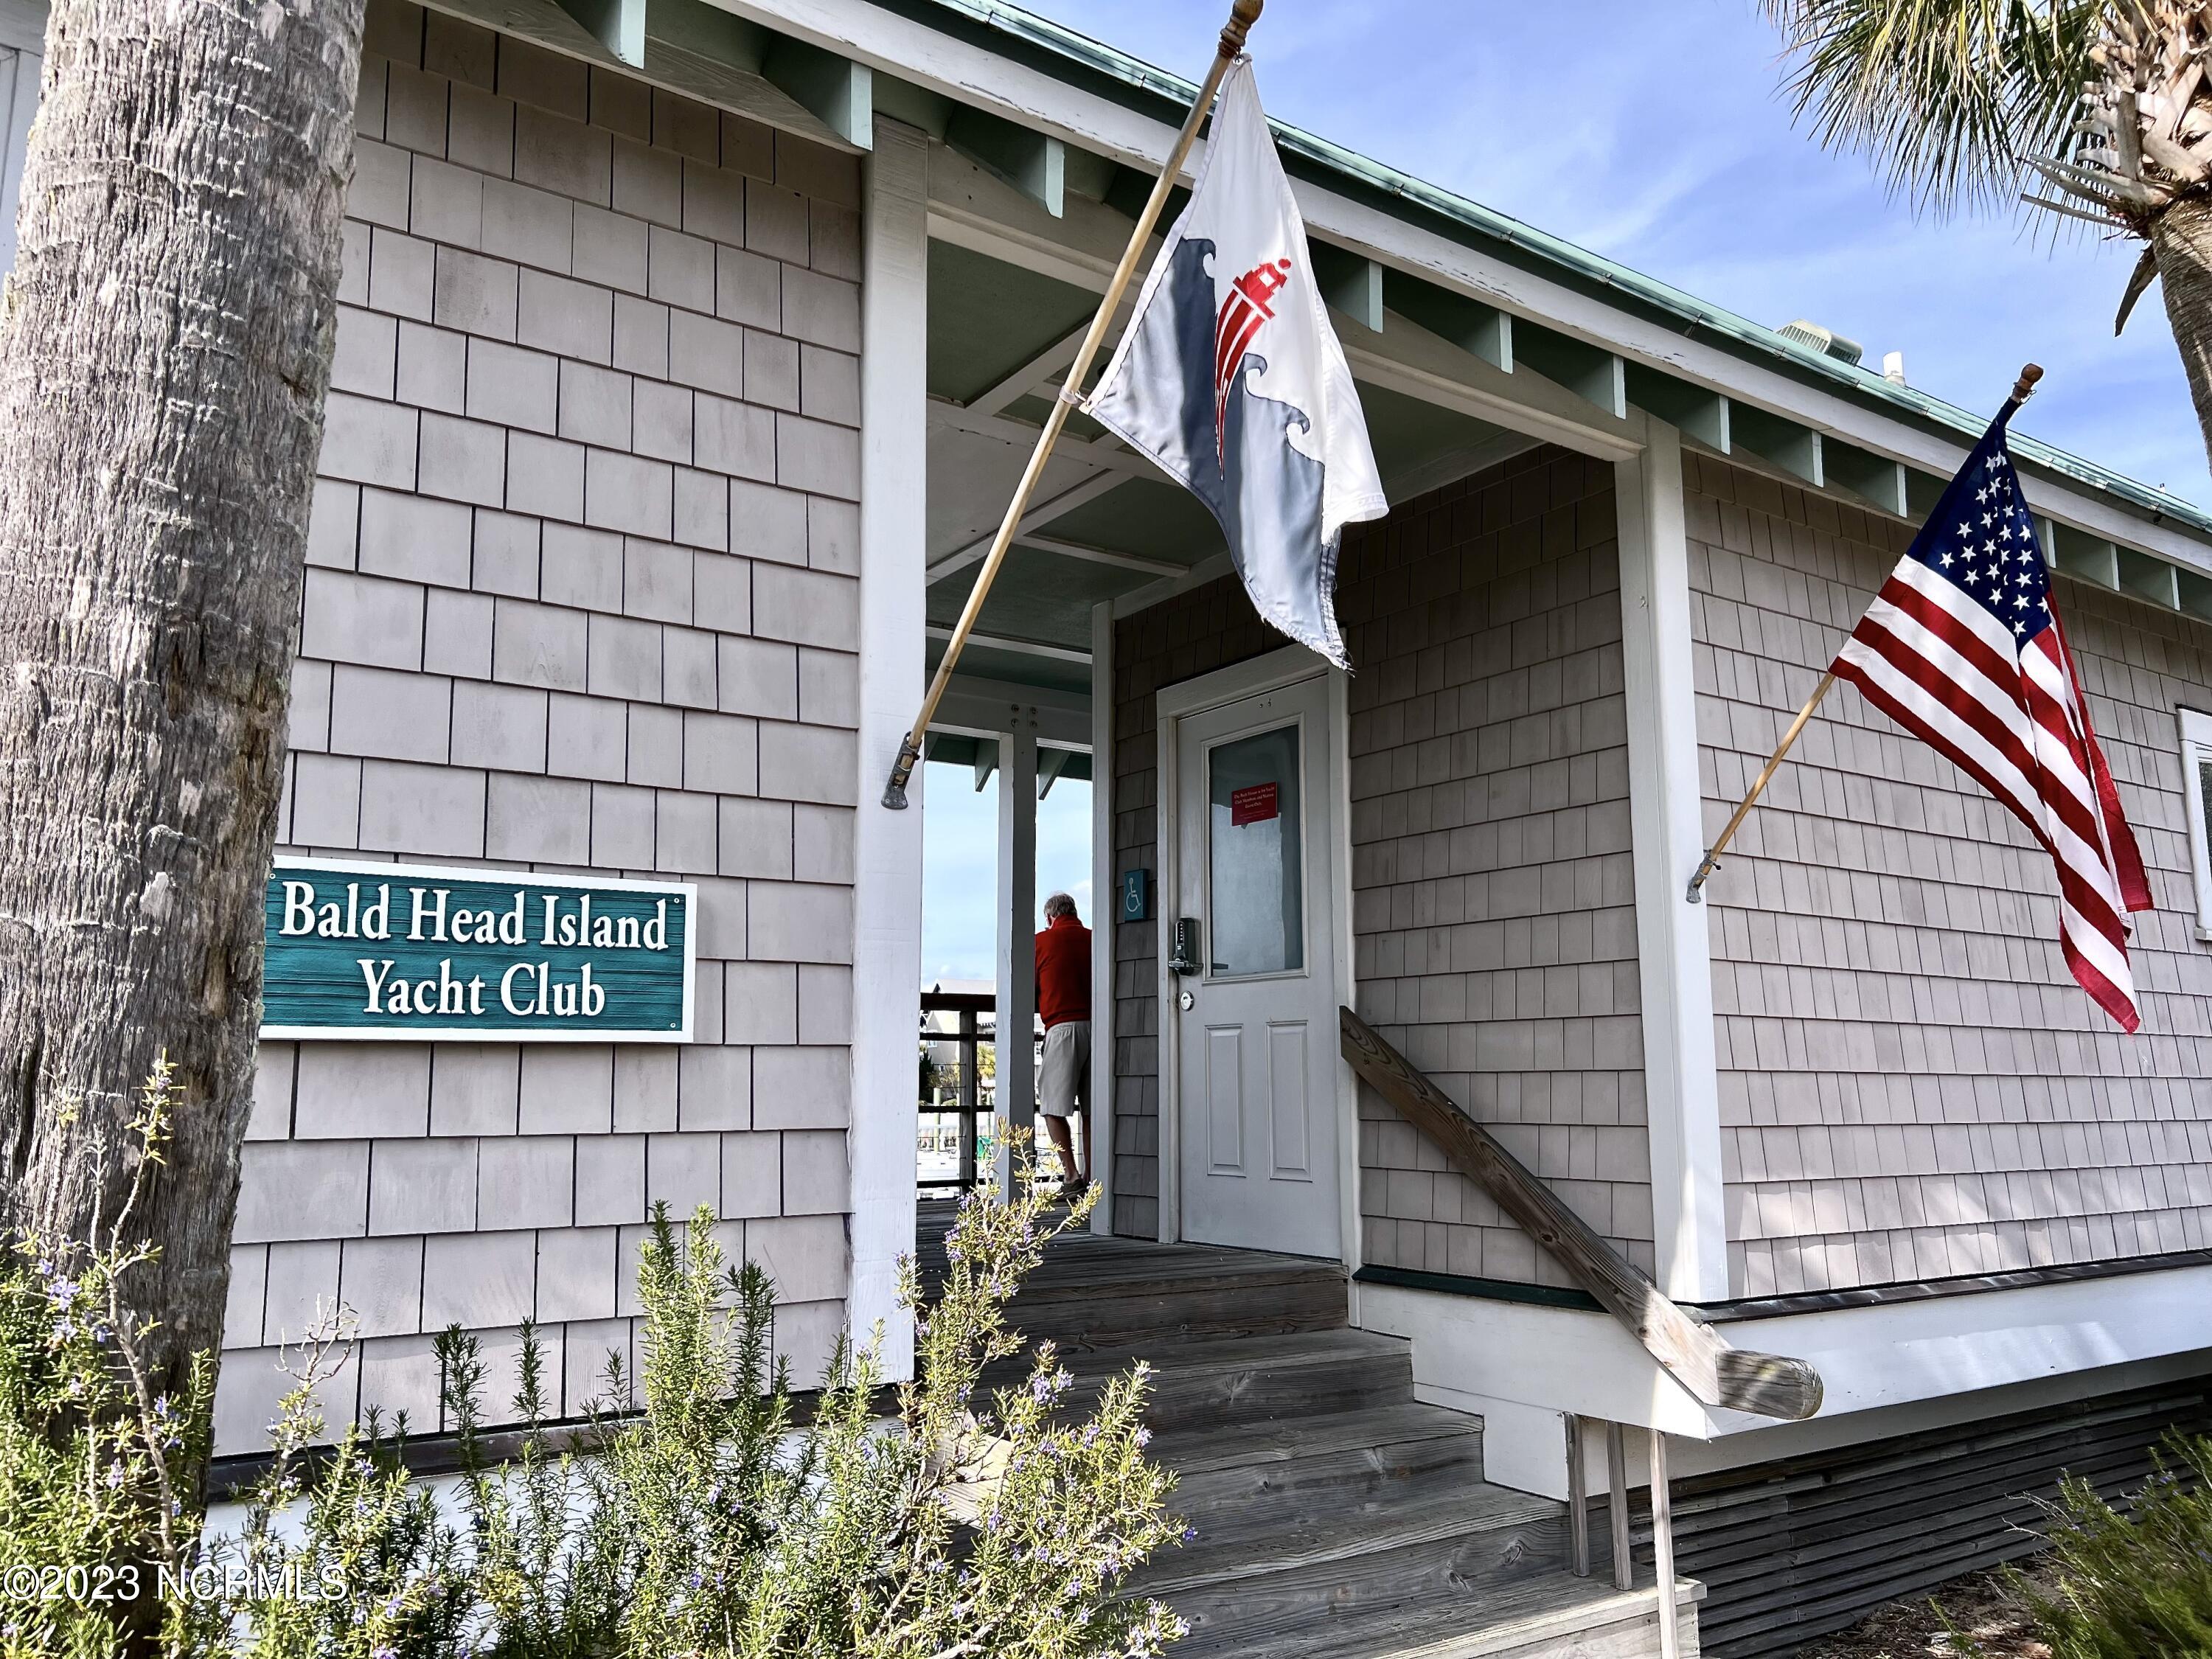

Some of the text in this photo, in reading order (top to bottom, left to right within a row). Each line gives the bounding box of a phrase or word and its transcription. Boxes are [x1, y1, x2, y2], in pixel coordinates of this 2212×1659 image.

[279, 881, 669, 950] Bald Head Island
[357, 959, 605, 1016] Yacht Club
